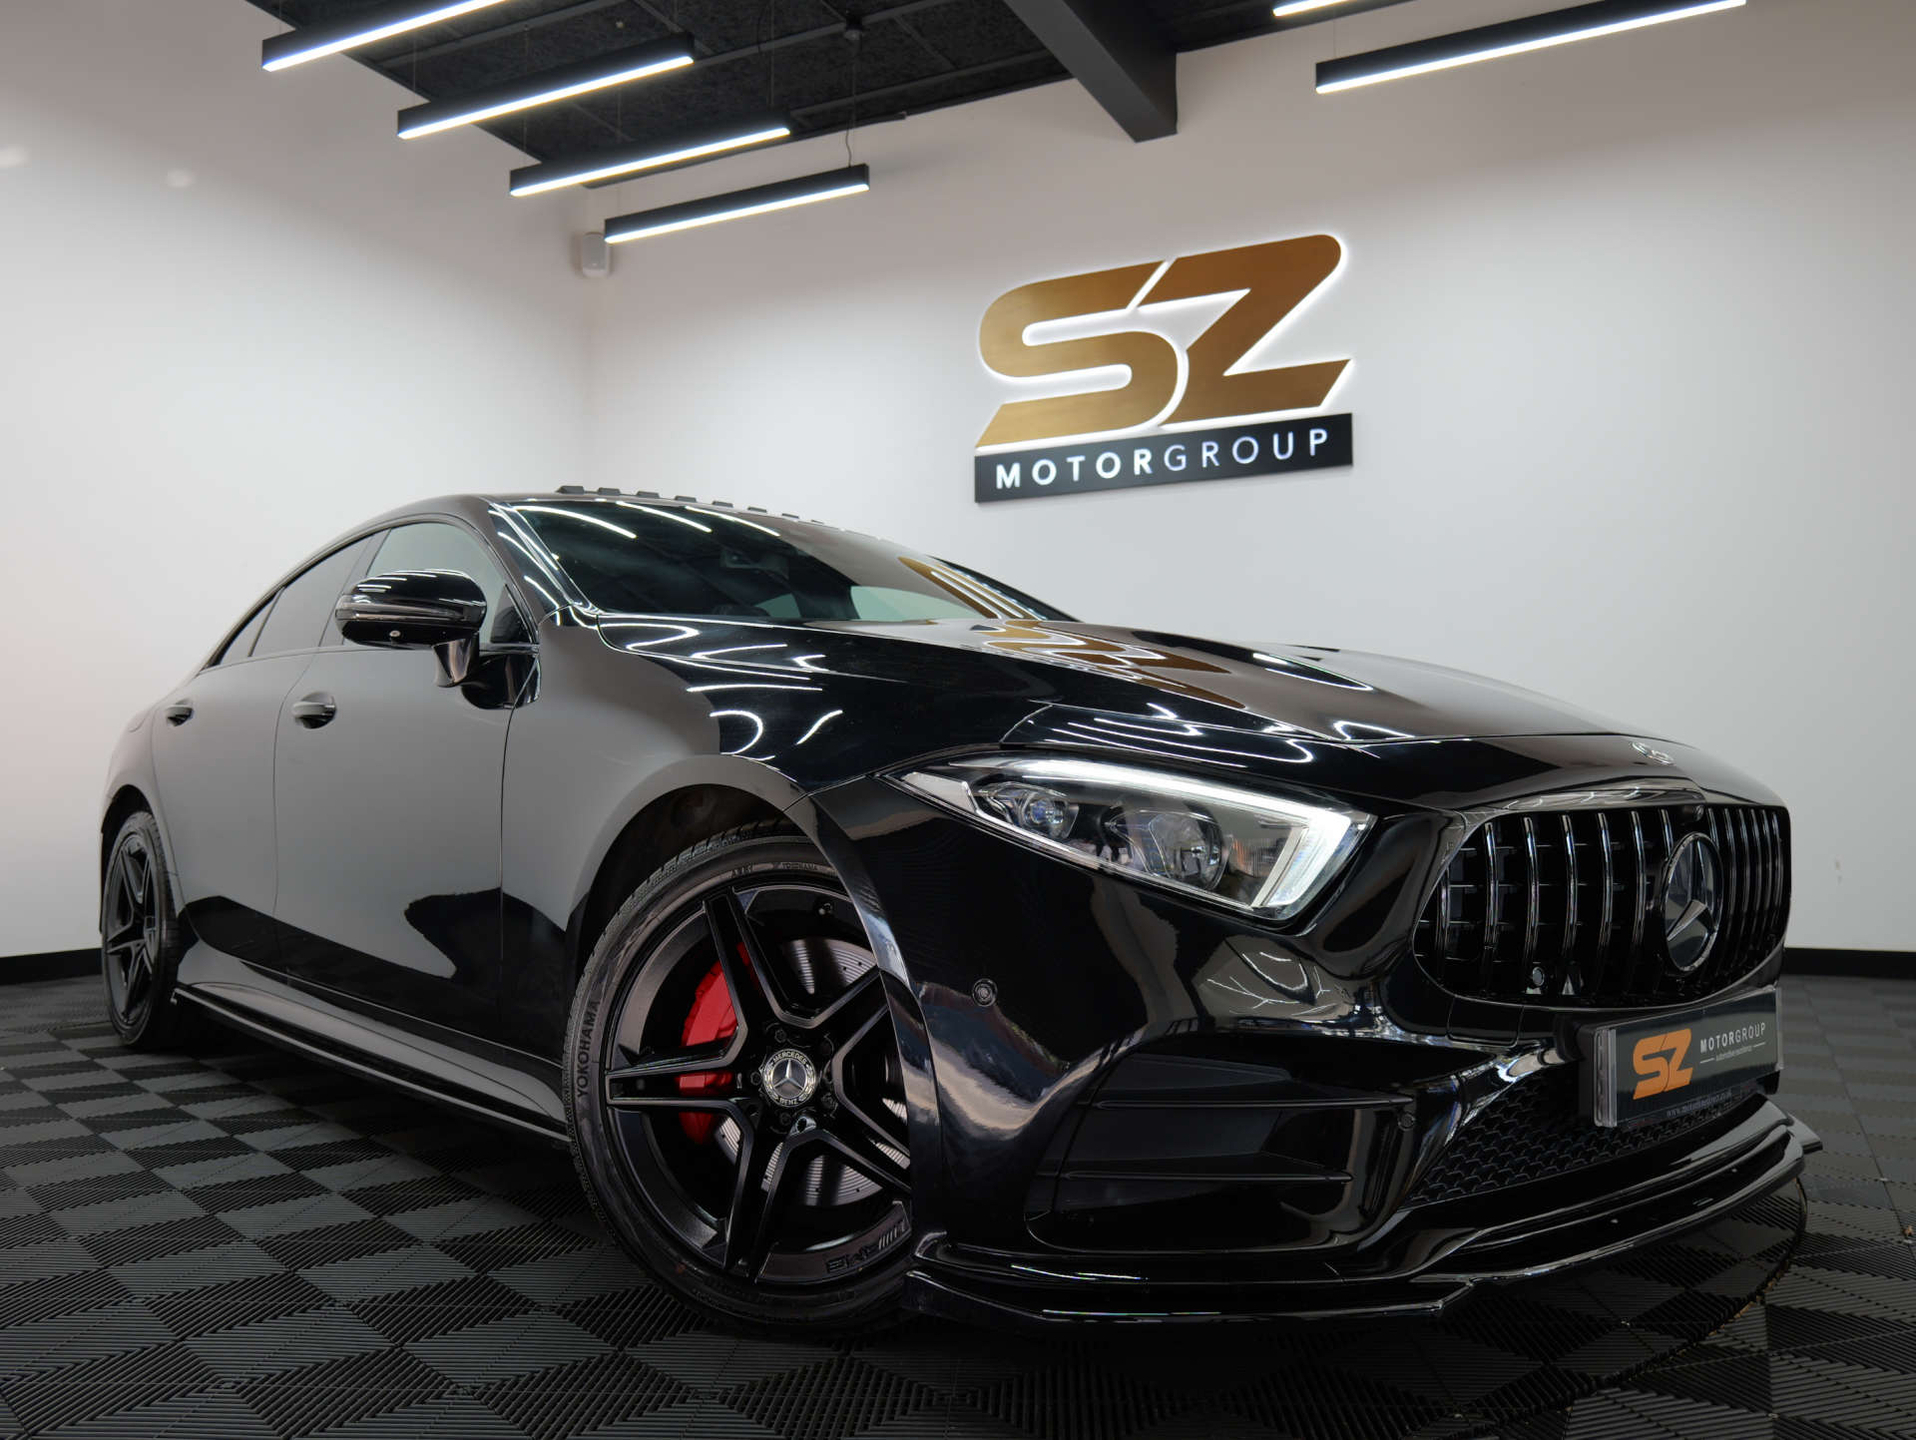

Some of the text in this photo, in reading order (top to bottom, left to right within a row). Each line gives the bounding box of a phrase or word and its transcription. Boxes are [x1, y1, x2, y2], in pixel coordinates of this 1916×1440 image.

[976, 234, 1351, 448] SZ
[996, 429, 1328, 490] MOTORGROUP
[576, 999, 601, 1098] YOKOHAMA
[772, 1051, 808, 1065] MERCEDES
[1632, 1028, 1693, 1100] SZ
[1700, 1022, 1766, 1053] MOTORGROUP
